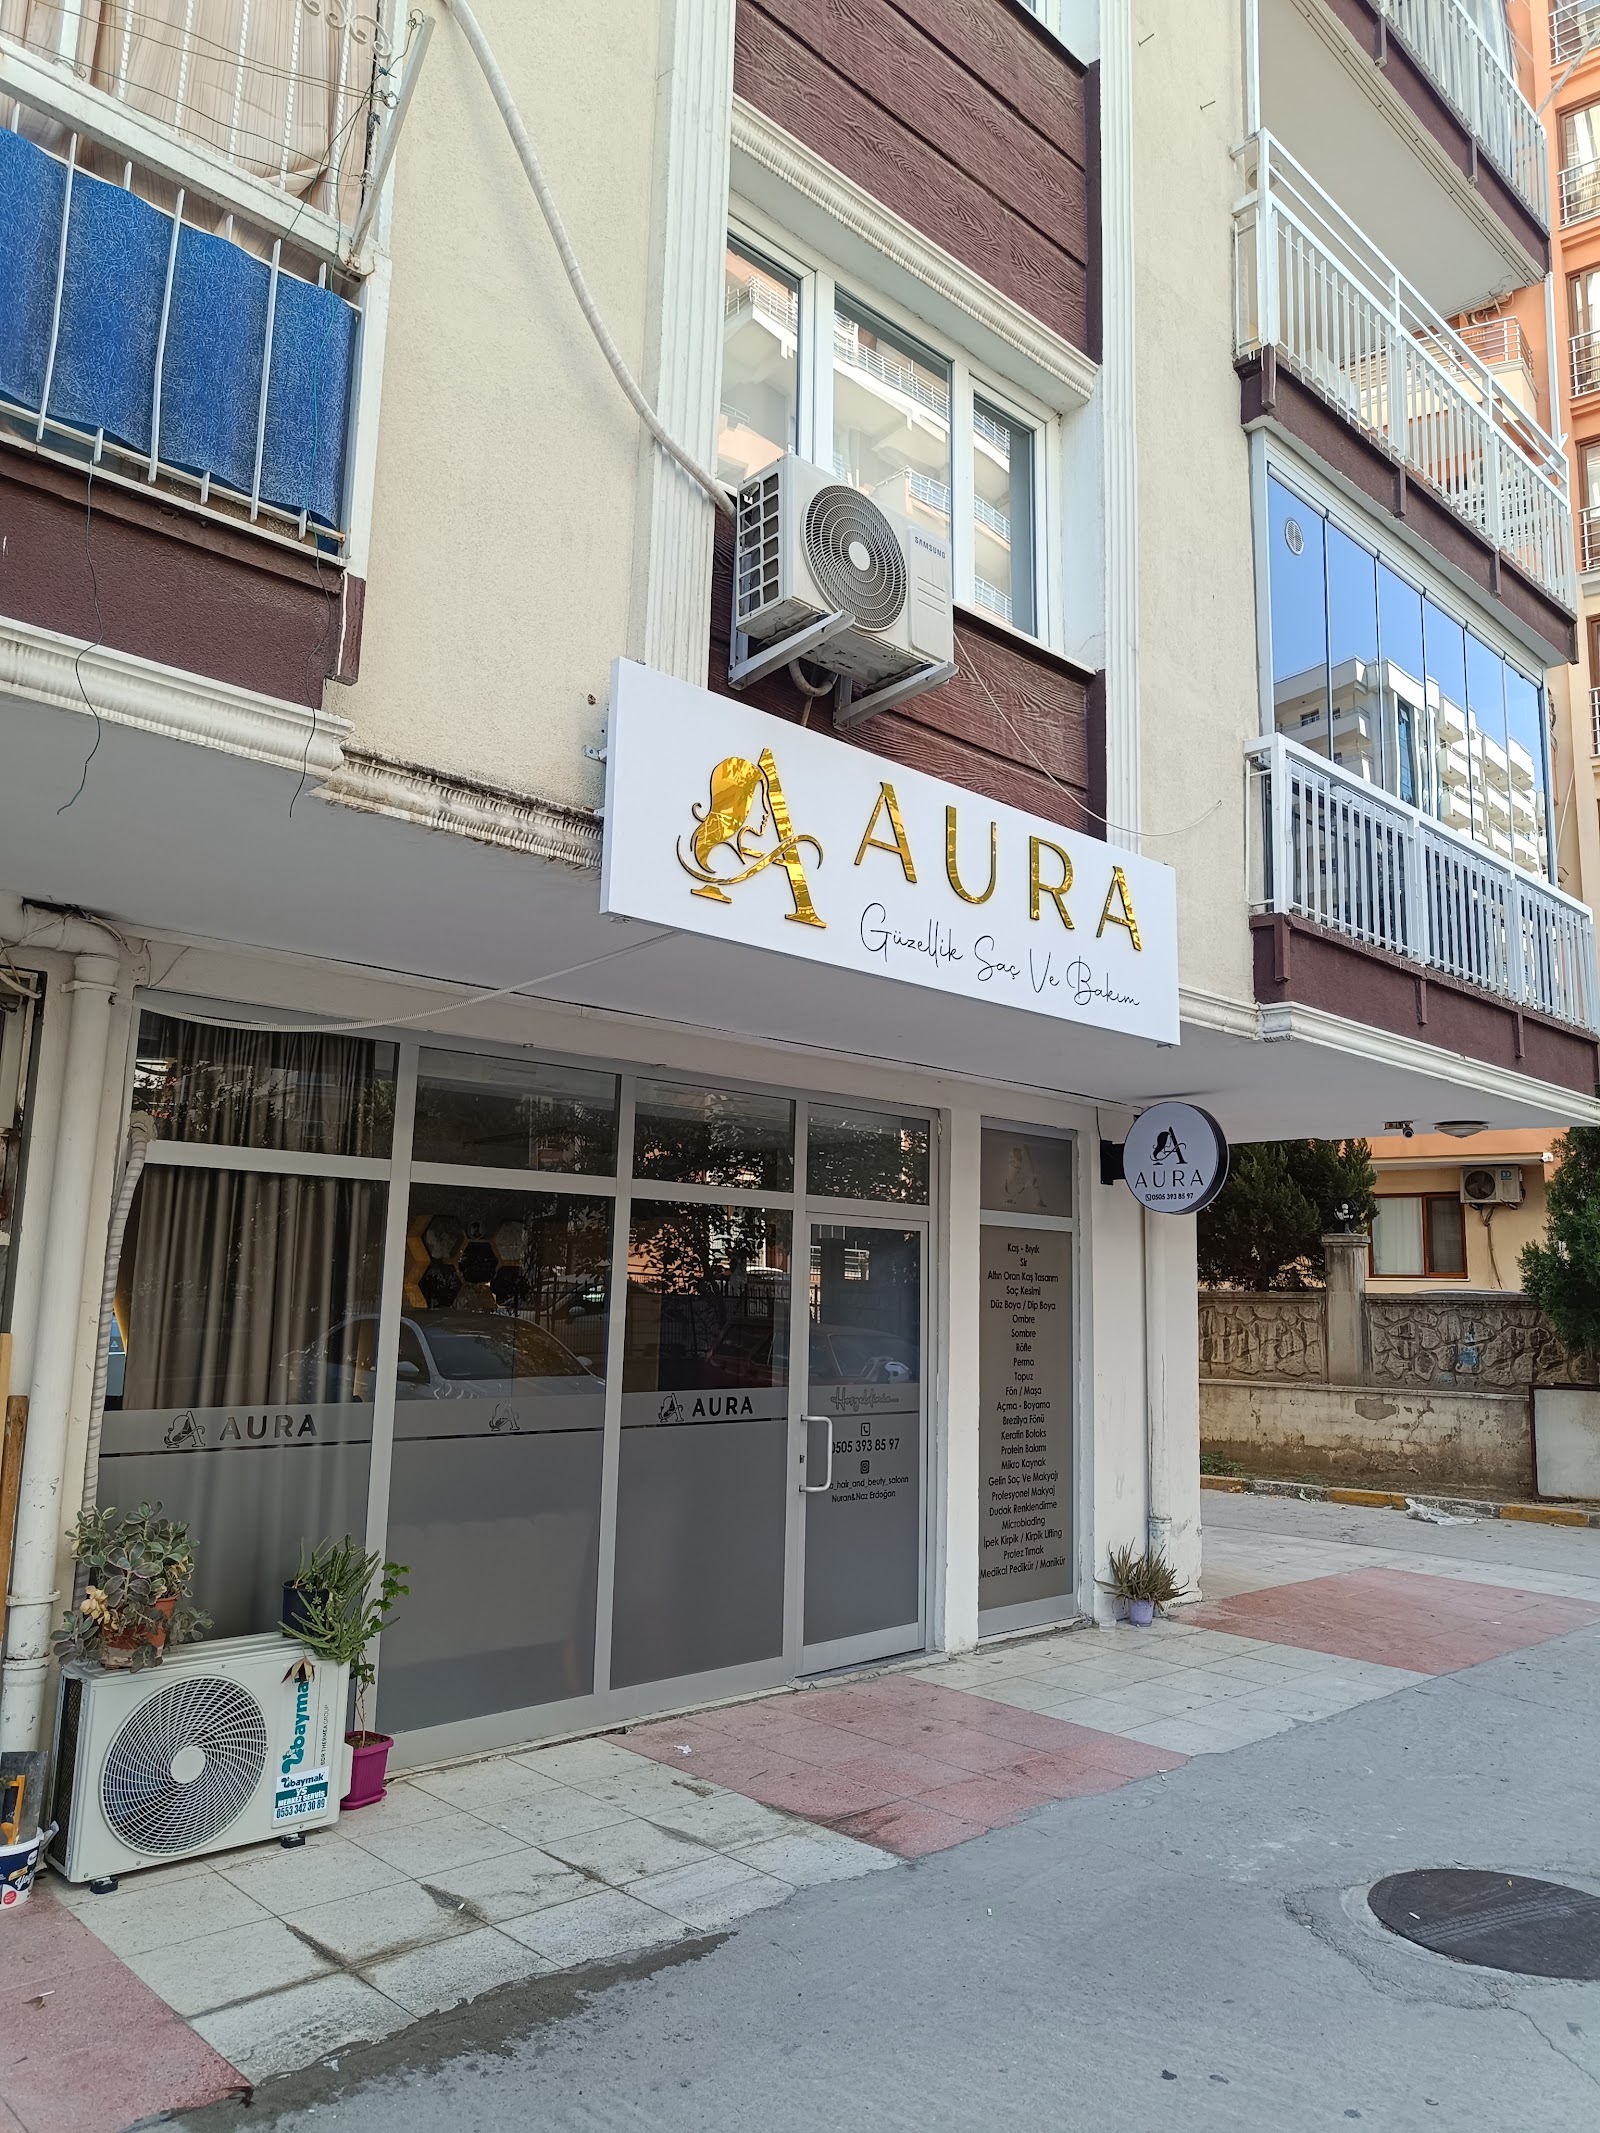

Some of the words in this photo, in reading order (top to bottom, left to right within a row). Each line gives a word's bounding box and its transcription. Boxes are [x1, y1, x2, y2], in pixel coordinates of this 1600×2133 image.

[915, 536, 946, 559] SAMSUNG
[853, 780, 1143, 953] AURA
[860, 902, 963, 968] Güzellik
[974, 935, 1020, 982] Saç
[1029, 948, 1060, 993] Ve
[1066, 955, 1140, 1006] Bakım
[1135, 1169, 1204, 1188] AURA
[1151, 1193, 1166, 1201] 0505
[1178, 1192, 1186, 1200] 85
[1004, 1272, 1020, 1281] Oran
[1006, 1286, 1019, 1296] Saç
[1020, 1286, 1041, 1296] Kesimi
[990, 1299, 1003, 1309] Düz
[1004, 1300, 1021, 1311] Boya
[1027, 1300, 1039, 1312] Dip
[1039, 1301, 1056, 1312] Boya
[1012, 1314, 1036, 1324] Ombre
[1011, 1328, 1037, 1338] Sombre
[1013, 1357, 1035, 1367] Perma
[1014, 1371, 1034, 1383] Topuz
[1005, 1386, 1018, 1396] Fön
[1023, 1385, 1042, 1397] Maşa
[692, 1395, 753, 1418] AURA
[996, 1401, 1018, 1412] Açma
[1023, 1400, 1051, 1411] Boyama
[219, 1413, 318, 1441] AURA
[1002, 1415, 1028, 1427] Brezilya
[1029, 1413, 1045, 1424] Fönü
[855, 1439, 873, 1453] 393
[875, 1438, 886, 1452] 85
[888, 1437, 900, 1450] 97
[1001, 1444, 1024, 1455] Protein
[1001, 1459, 1020, 1470] Mikro
[1021, 1456, 1047, 1469] Kaynak
[988, 1475, 1007, 1486] Gelin
[1007, 1474, 1021, 1485] Saç
[1022, 1473, 1032, 1482] Ve
[991, 1487, 1030, 1501] Profesyonel
[1031, 1484, 1056, 1497] Makyaj
[989, 1504, 1012, 1516] Dudak
[1013, 1500, 1058, 1514] Renklendirme
[1001, 1516, 1046, 1530] Microblading
[983, 1536, 1000, 1549] İpek
[1000, 1533, 1020, 1546] Kirpik
[1025, 1530, 1044, 1543] Kirpik
[1003, 1549, 1024, 1560] Protez
[980, 1565, 1008, 1580] Medikal
[1009, 1560, 1034, 1574] Pedikür
[1039, 1555, 1066, 1569] Manikür
[291, 1677, 310, 1751] bayma
[290, 1772, 325, 1787] baymak
[302, 1790, 326, 1802] SERVİS
[276, 1806, 294, 1819] 0553
[293, 1801, 307, 1815] 342
[307, 1799, 316, 1811] 30
